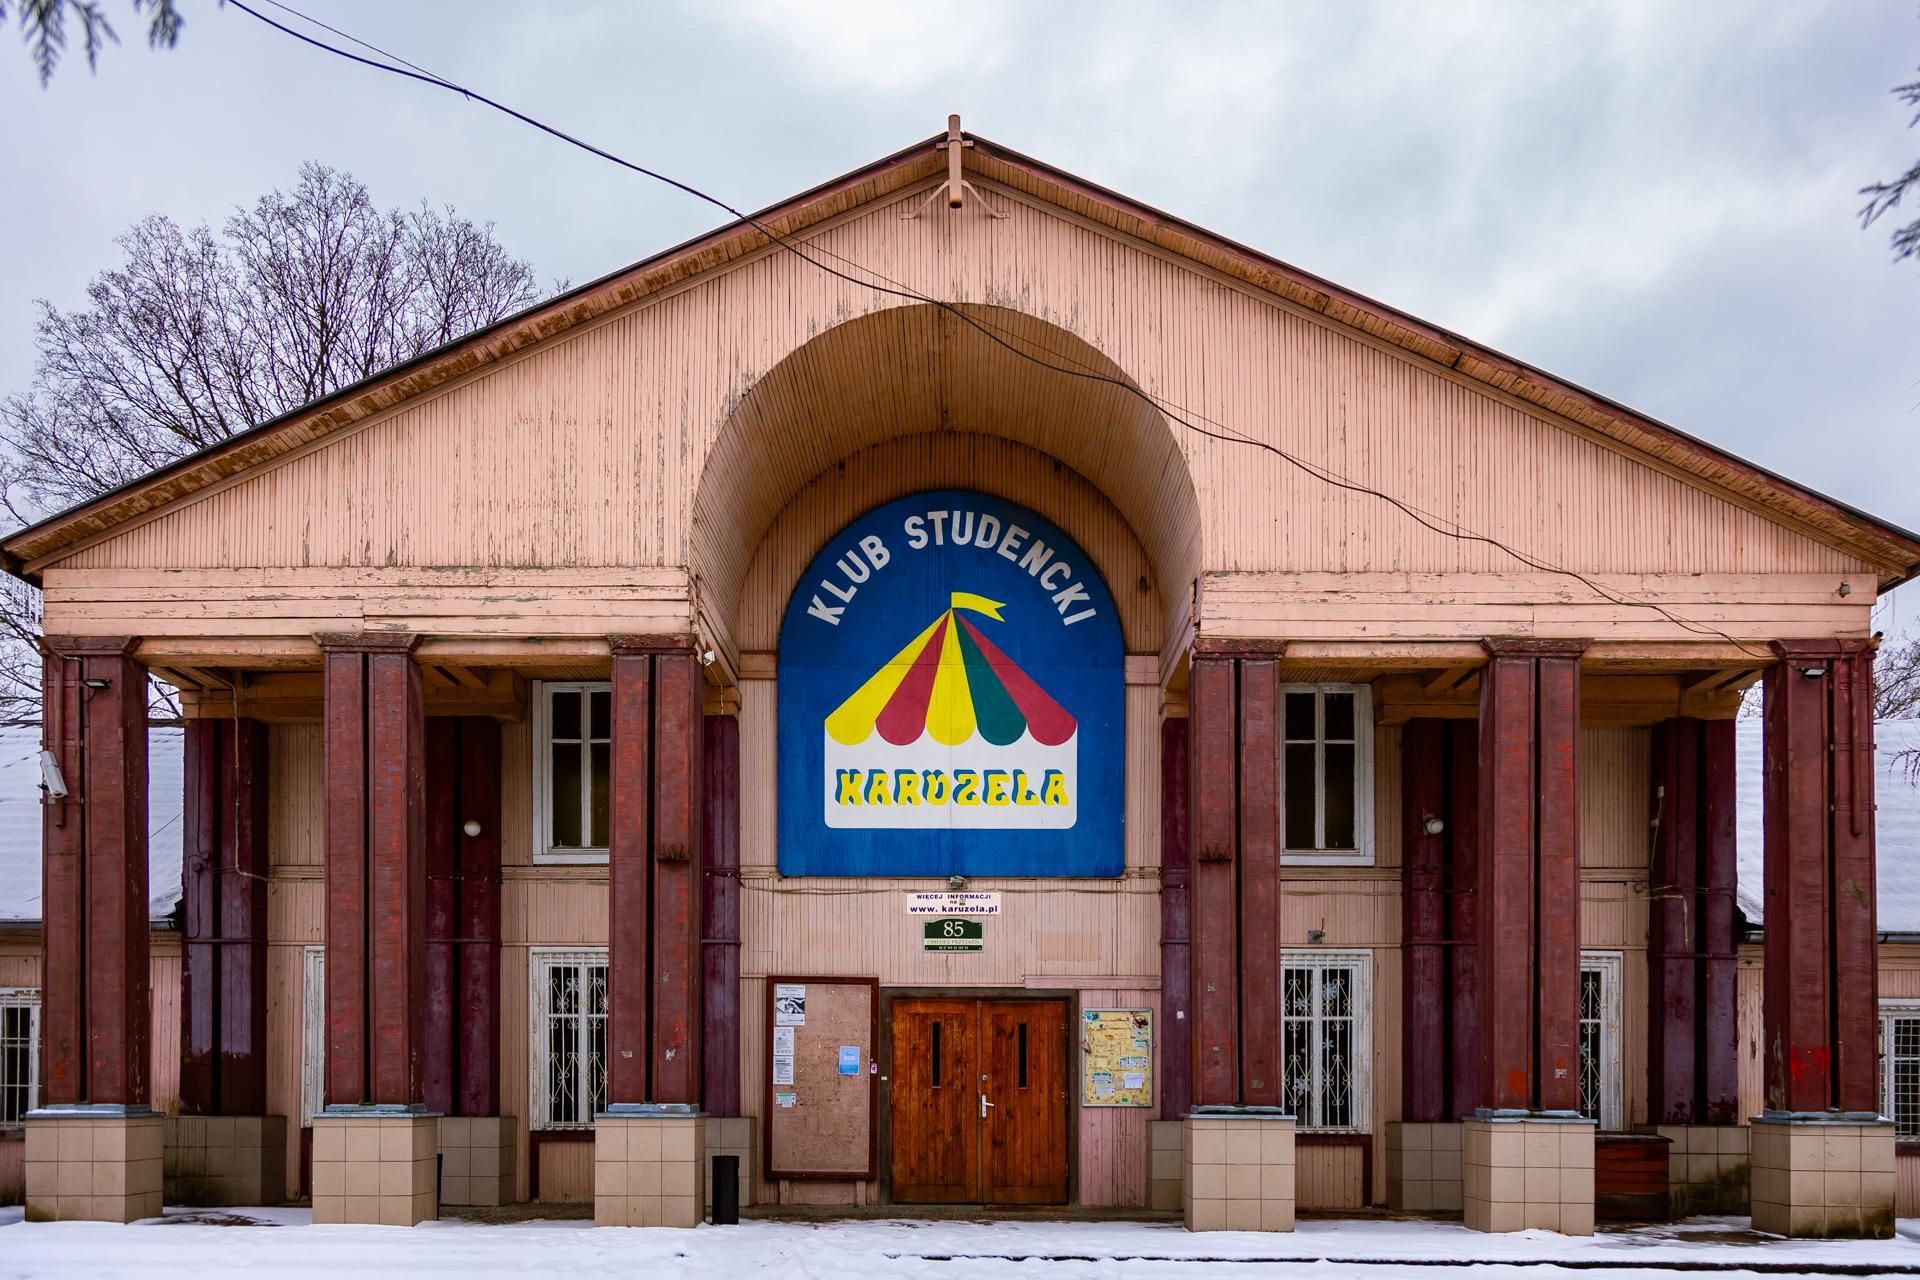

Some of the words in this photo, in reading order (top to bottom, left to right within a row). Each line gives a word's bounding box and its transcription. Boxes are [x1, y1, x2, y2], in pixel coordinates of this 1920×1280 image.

[807, 535, 890, 626] KLUB
[904, 510, 1097, 626] STUDENCKI
[835, 769, 1069, 807] KARUZELA
[944, 922, 964, 937] 85
